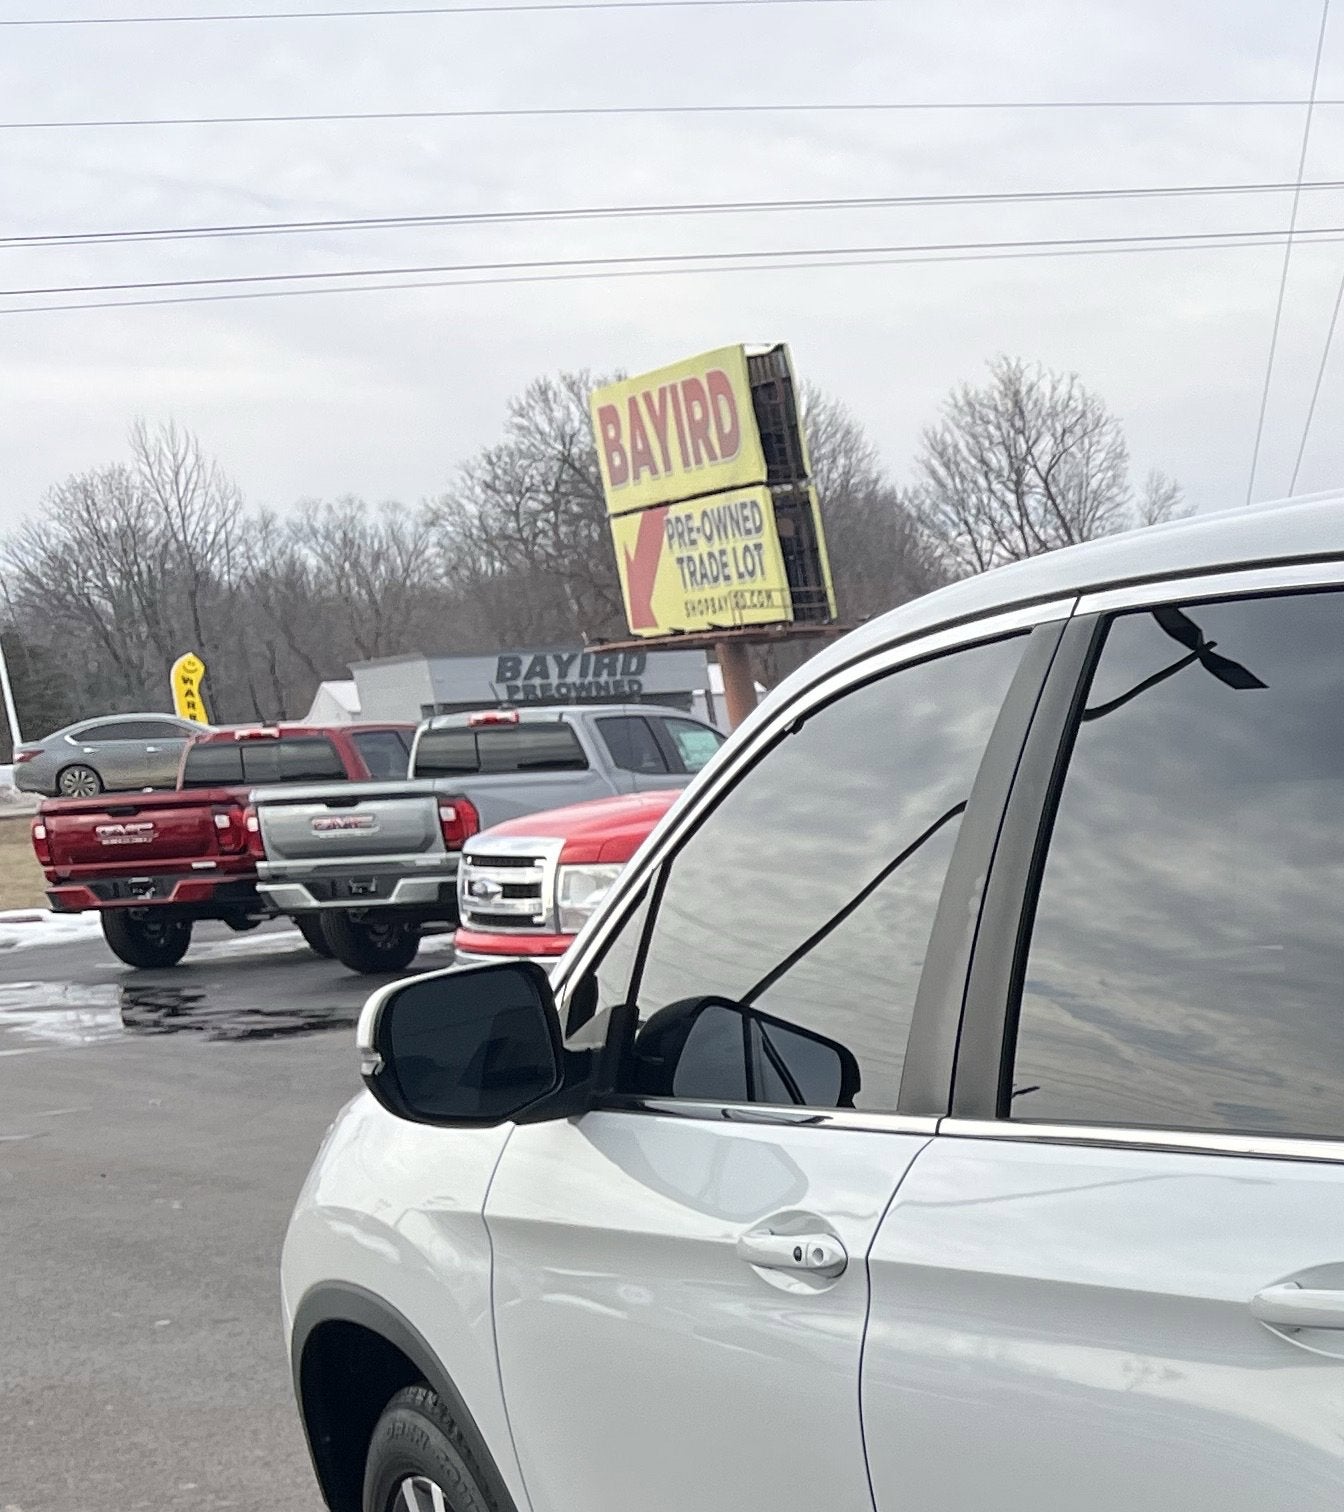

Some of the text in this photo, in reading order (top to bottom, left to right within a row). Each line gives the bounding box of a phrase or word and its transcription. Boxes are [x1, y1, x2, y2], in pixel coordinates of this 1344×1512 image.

[597, 369, 742, 488] BAYIRD
[664, 500, 764, 551] PRE-OWNED
[675, 542, 767, 591] TRADE LOT
[496, 652, 648, 684] BAYIRD
[505, 679, 644, 702] PREOWNED
